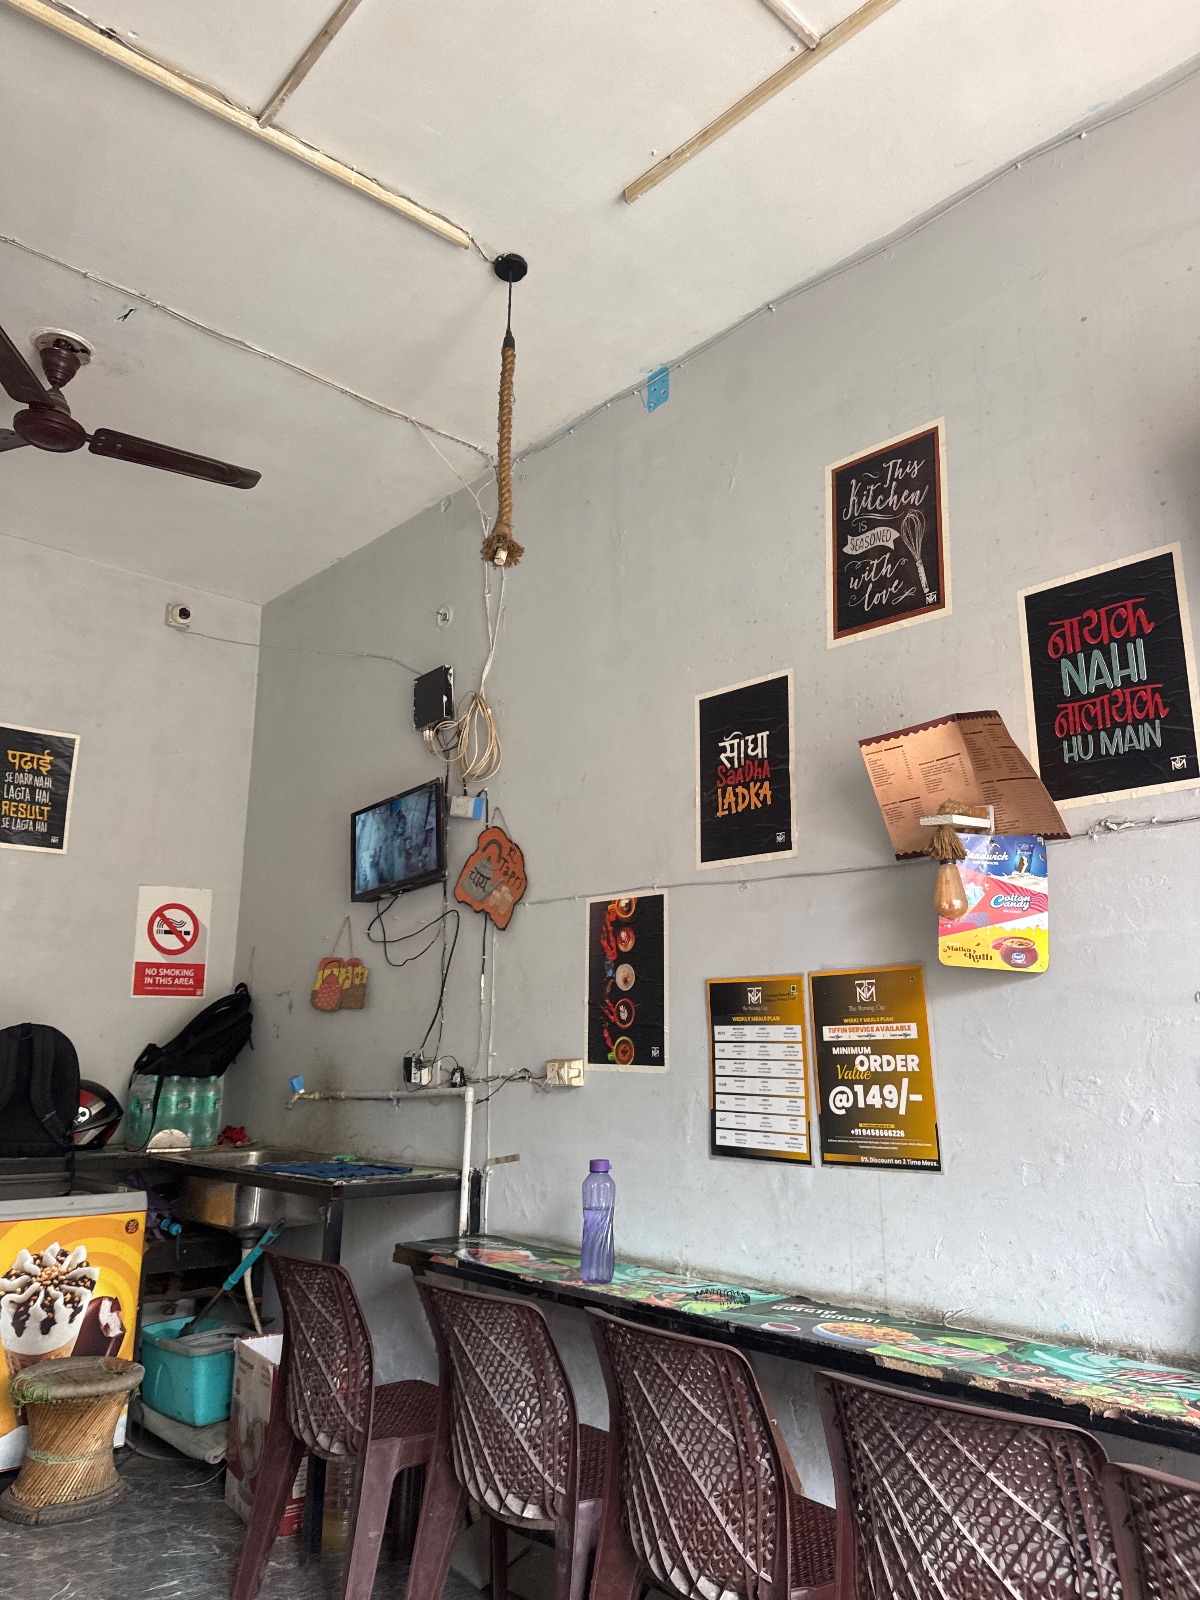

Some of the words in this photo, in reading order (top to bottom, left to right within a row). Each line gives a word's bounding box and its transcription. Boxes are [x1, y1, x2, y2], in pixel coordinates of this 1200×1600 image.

[882, 458, 926, 488] This
[842, 479, 929, 520] Kitchen
[857, 520, 868, 532] IS
[850, 528, 892, 552] SEASONED
[849, 552, 900, 590] with
[1047, 597, 1155, 660] नायक
[1060, 638, 1148, 697] NAHI
[1054, 683, 1170, 738] नालायक
[718, 731, 770, 769] सीधा
[1062, 733, 1094, 764] HU
[1099, 719, 1162, 756] MAIN
[7, 749, 54, 776] पढ़ाई
[4, 771, 14, 783] SE
[14, 772, 34, 786] DARR
[3, 783, 31, 803] LAGTA
[715, 781, 772, 818] LADKA
[1, 800, 52, 821] RESULT
[1, 817, 10, 829] SE
[11, 817, 34, 832] LAGTA
[35, 820, 48, 833] HAI
[144, 977, 153, 985] IN
[154, 977, 173, 985] THIS
[145, 968, 158, 976] NO
[158, 968, 195, 977] SMOKING
[832, 1046, 872, 1055] MINIMUM
[855, 1054, 920, 1072] ORDER
[836, 1064, 872, 1080] Value
[828, 1077, 923, 1116] @149/-
